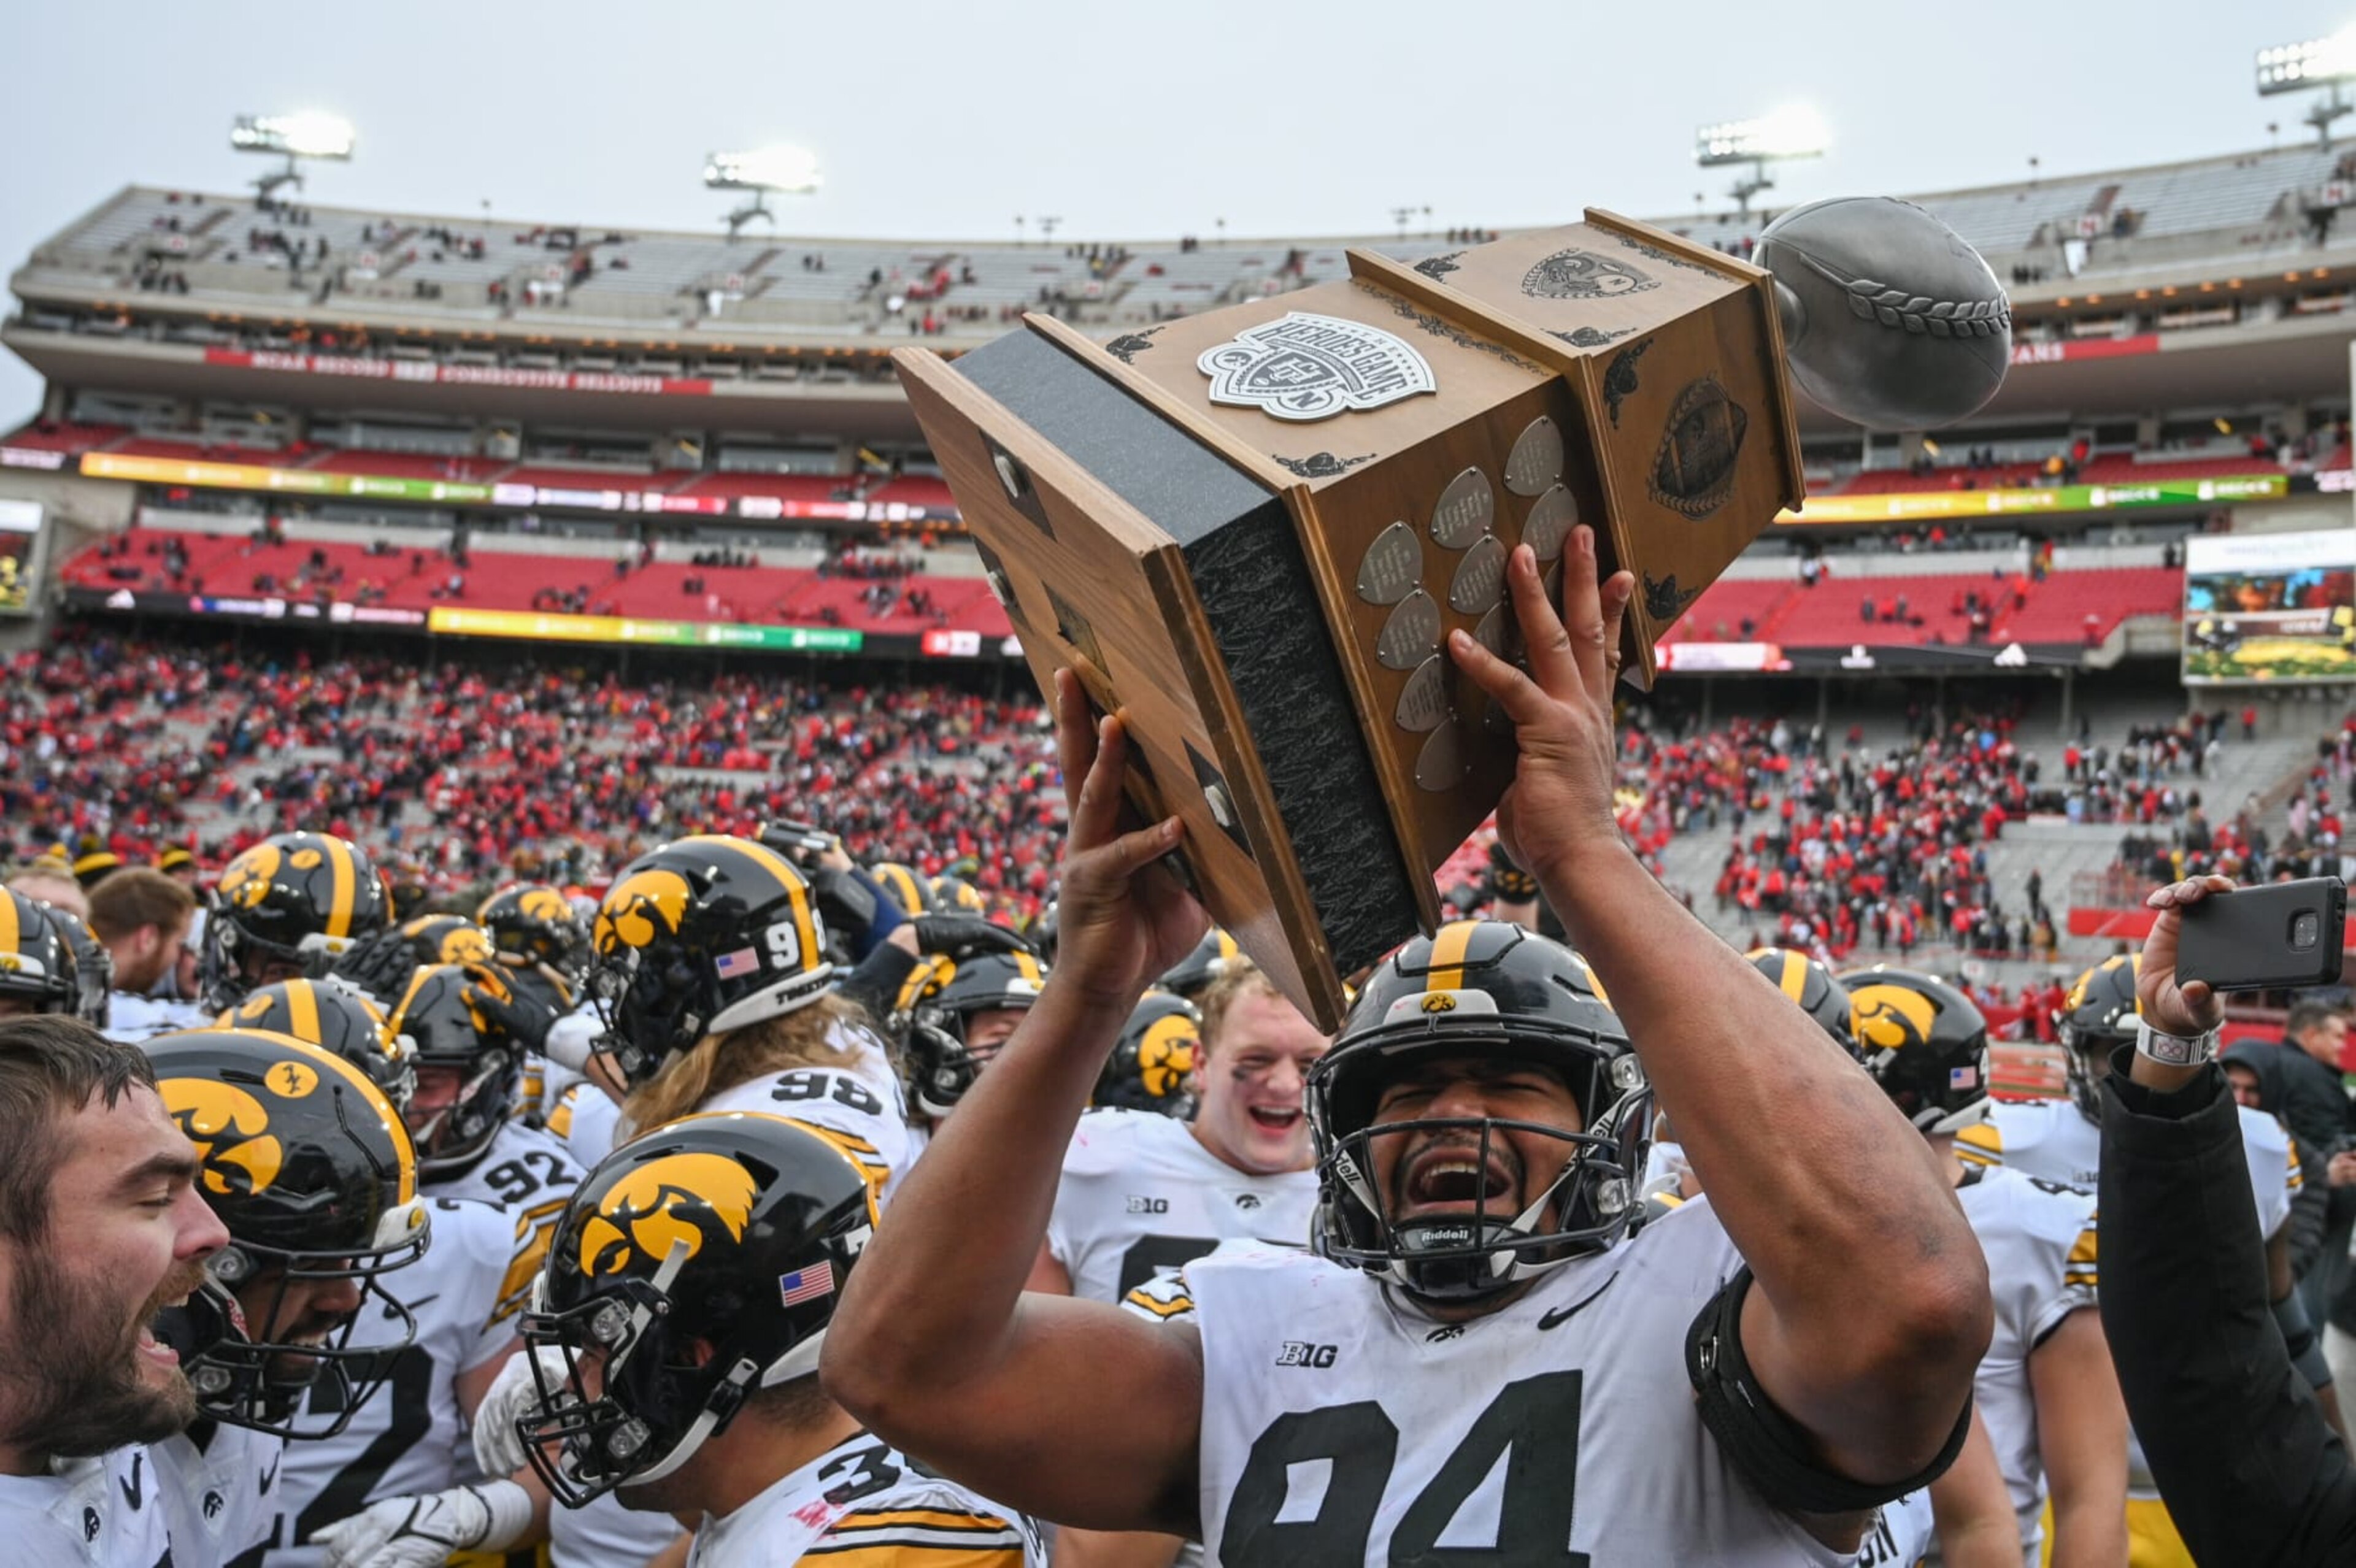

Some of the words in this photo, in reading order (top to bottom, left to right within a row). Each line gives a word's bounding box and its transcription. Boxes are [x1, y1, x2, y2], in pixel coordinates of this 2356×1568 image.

[1250, 322, 1376, 358] HEROES
[1350, 351, 1408, 401] GAME
[2011, 341, 2064, 363] ANS
[771, 1072, 883, 1116] 98
[483, 1150, 579, 1203] 92
[1422, 1229, 1468, 1242] Riddell
[1219, 1369, 1591, 1568] 94
